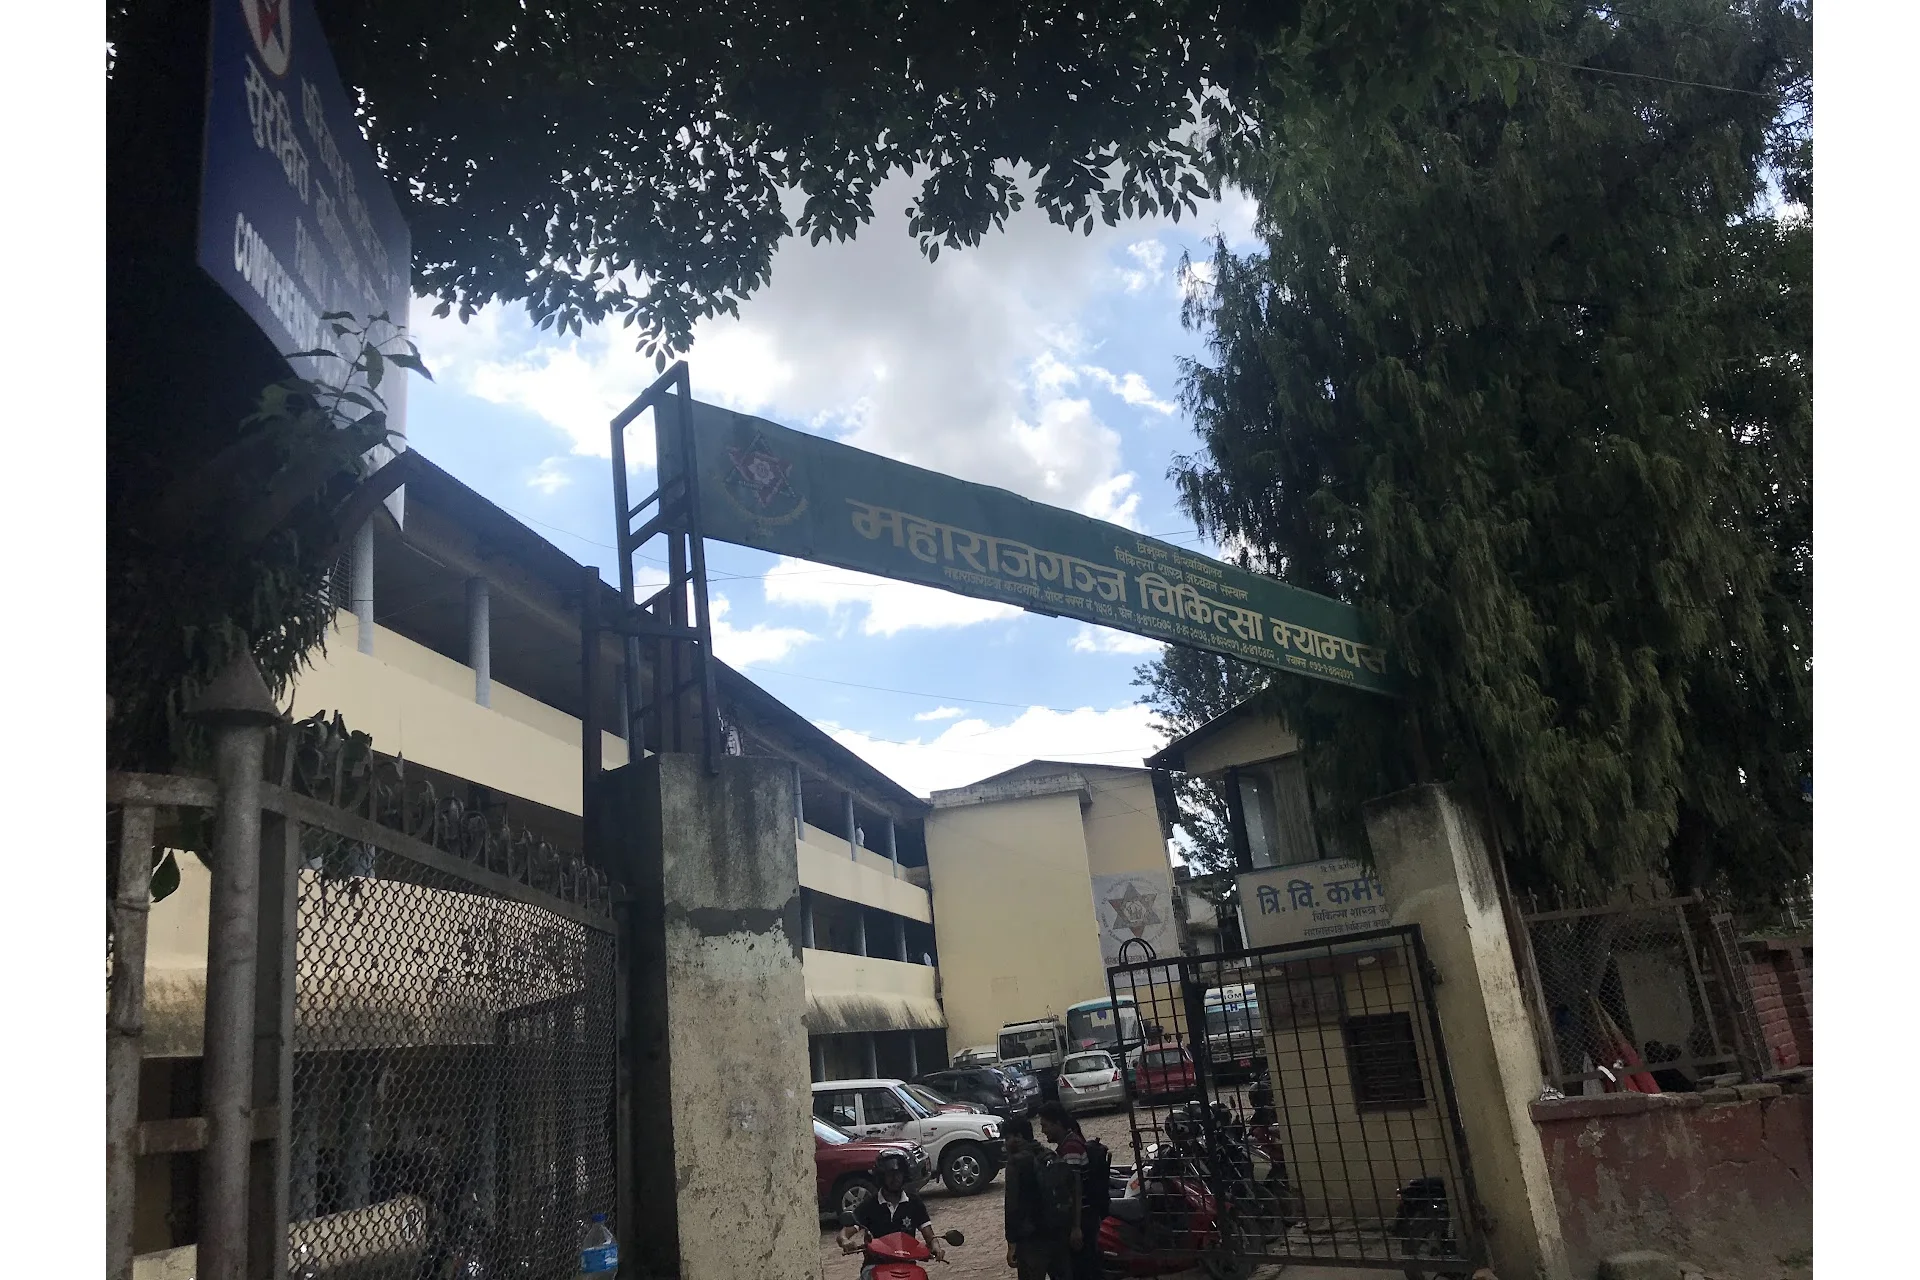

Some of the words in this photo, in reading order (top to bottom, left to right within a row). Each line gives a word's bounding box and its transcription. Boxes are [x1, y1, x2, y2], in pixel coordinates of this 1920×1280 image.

[244, 53, 309, 204] सुरक्षित
[845, 497, 1127, 602] महाराजगञ्ज
[1134, 571, 1263, 642] चिकित्सा
[1269, 616, 1387, 674] क्याम्पस
[1114, 546, 1155, 571] चिकित्सा
[1186, 572, 1218, 593] अध्ययन
[1220, 582, 1249, 601] संस्थान
[1137, 540, 1168, 560] त्रिभुवन
